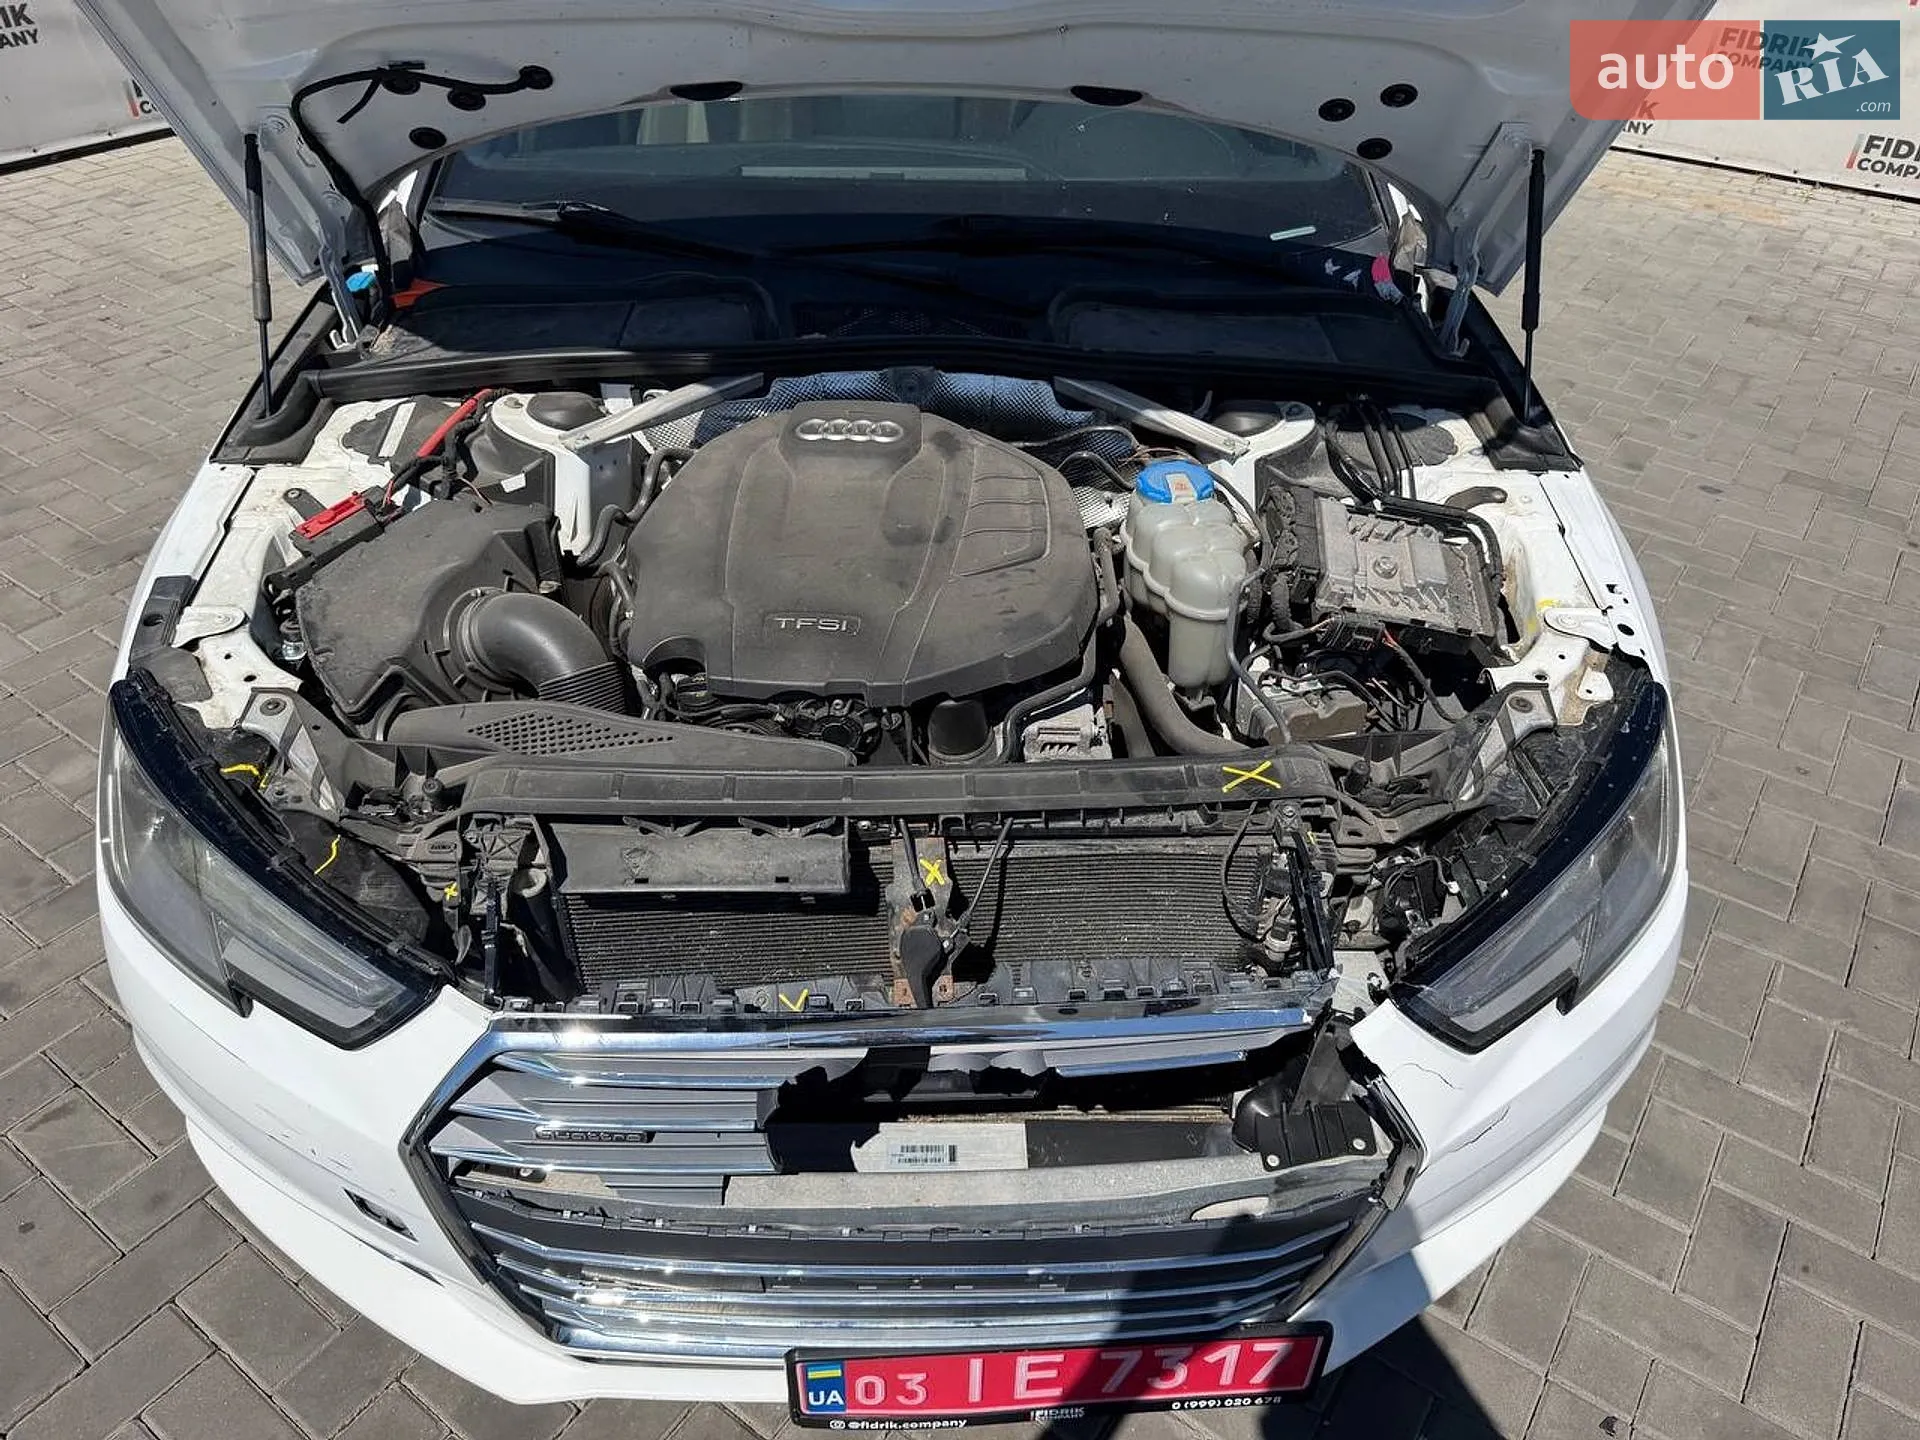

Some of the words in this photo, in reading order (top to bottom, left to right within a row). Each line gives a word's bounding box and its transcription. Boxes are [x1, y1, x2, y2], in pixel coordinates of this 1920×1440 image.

[1863, 134, 1920, 162] FID
[1857, 157, 1920, 180] COMP
[773, 617, 848, 631] TFSI
[854, 1372, 928, 1406] 03
[1100, 1341, 1295, 1394] 7317
[807, 1390, 845, 1407] UA
